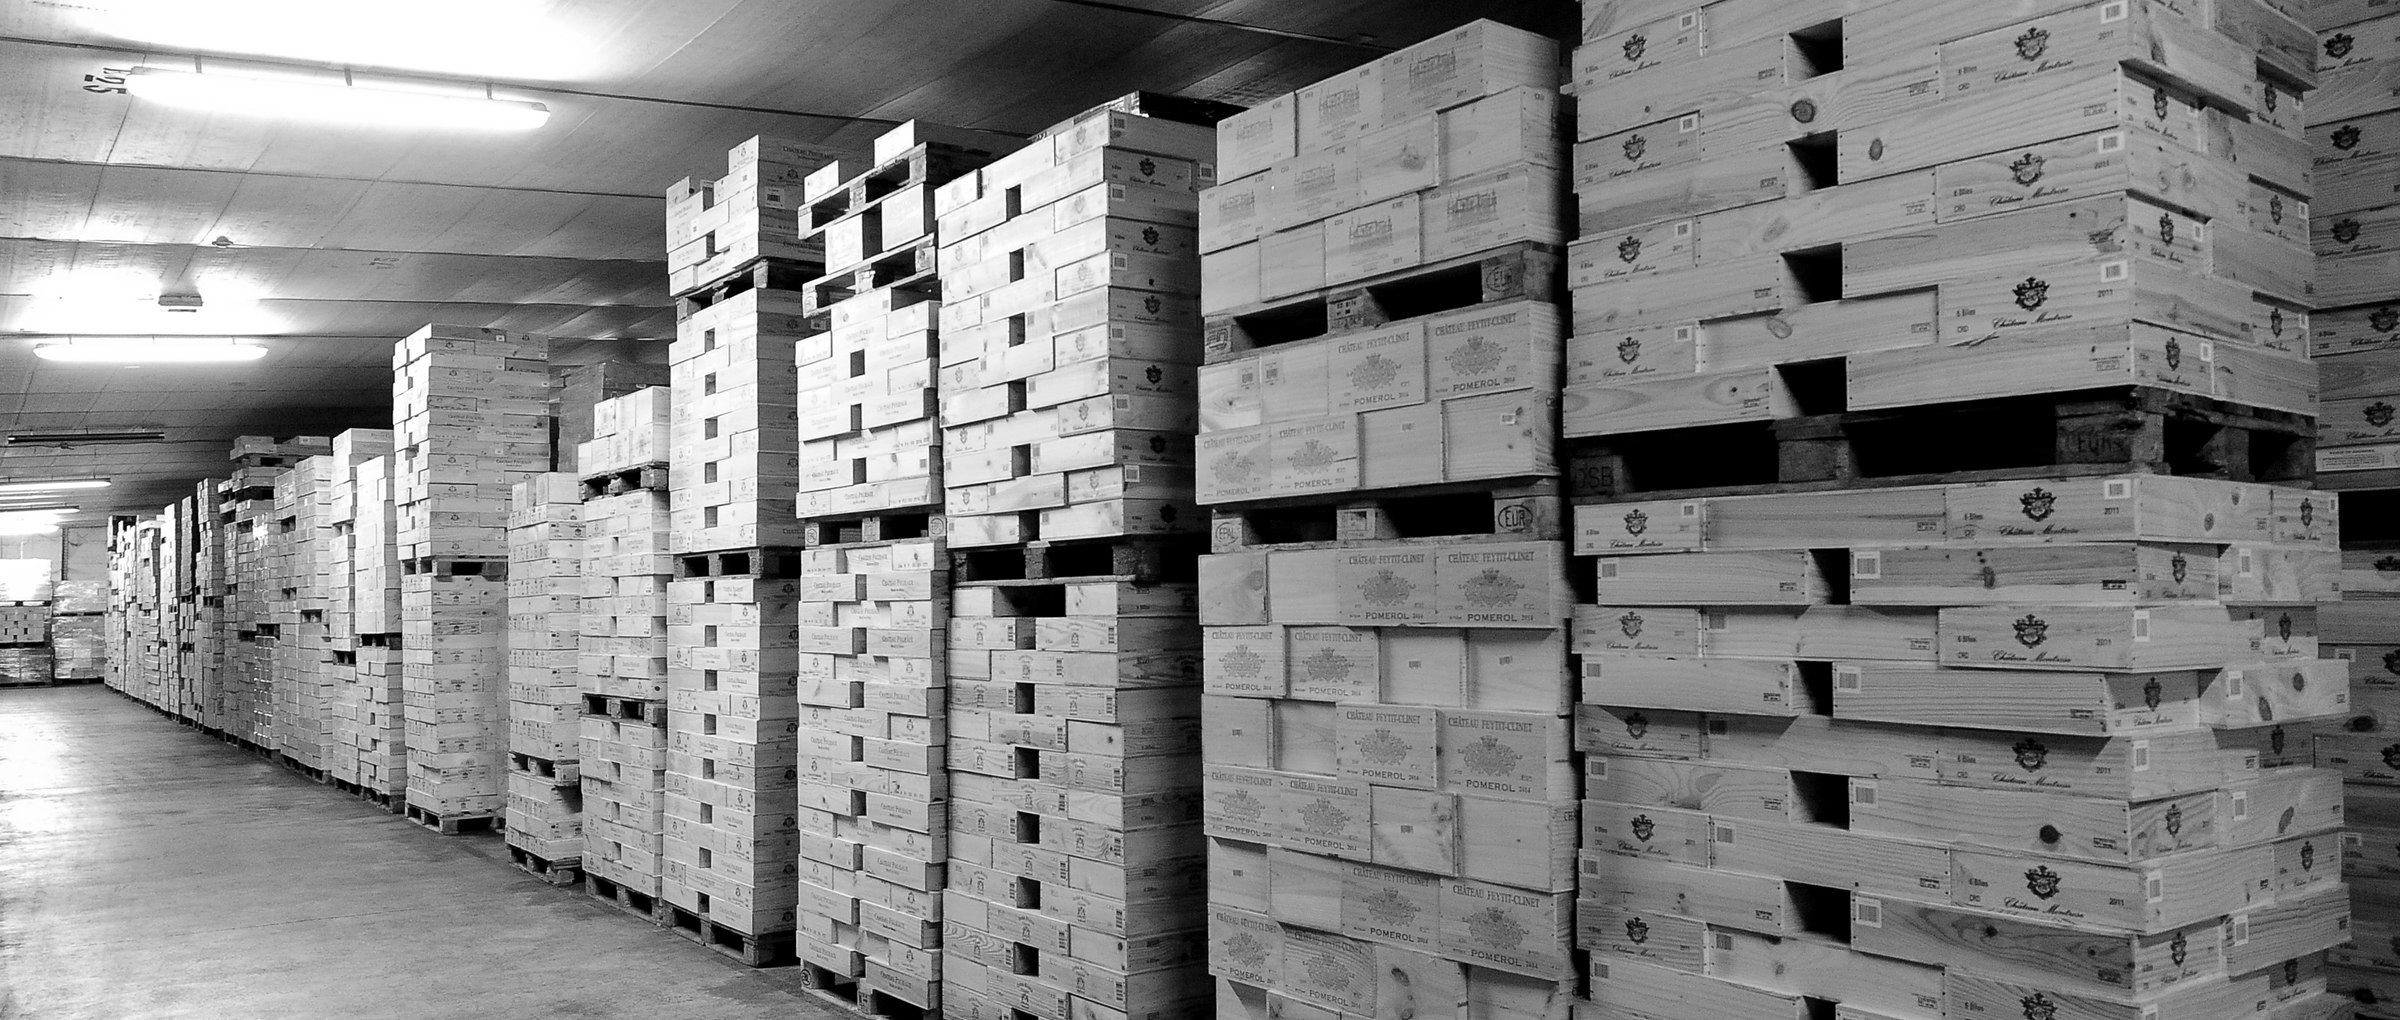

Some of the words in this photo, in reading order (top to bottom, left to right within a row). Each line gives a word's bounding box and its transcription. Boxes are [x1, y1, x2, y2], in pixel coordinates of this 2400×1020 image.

[1435, 323, 1464, 337] CHÂTEAU
[1453, 378, 1501, 392] POMEROL
[1354, 393, 1396, 405] POMEROL
[1294, 478, 1333, 489] POMEROL
[1216, 487, 1250, 496] POMEROL
[1506, 509, 1525, 529] EUR
[1349, 552, 1376, 565] CHÂTEAU
[1448, 551, 1479, 563] CHÂTEAU
[1365, 612, 1410, 620] POMEROL
[1467, 614, 1517, 622] POMEROL
[1225, 683, 1261, 691] POMEROL
[1309, 687, 1349, 696] POMEROL
[1346, 709, 1374, 722] CHÂTEAU
[1448, 715, 1479, 729] CHÂTEAU
[1362, 769, 1404, 780] POMEROL
[1466, 780, 1516, 792] POMEROL
[1224, 826, 1261, 837] POMEROL
[1304, 837, 1345, 850] POMEROL
[1452, 884, 1484, 900] CHÂTEAU
[1370, 927, 1414, 943] POMEROL
[1471, 949, 1522, 967] POMEROL
[1229, 968, 1265, 983] POMEROL
[1309, 989, 1349, 1006] POMEROL
